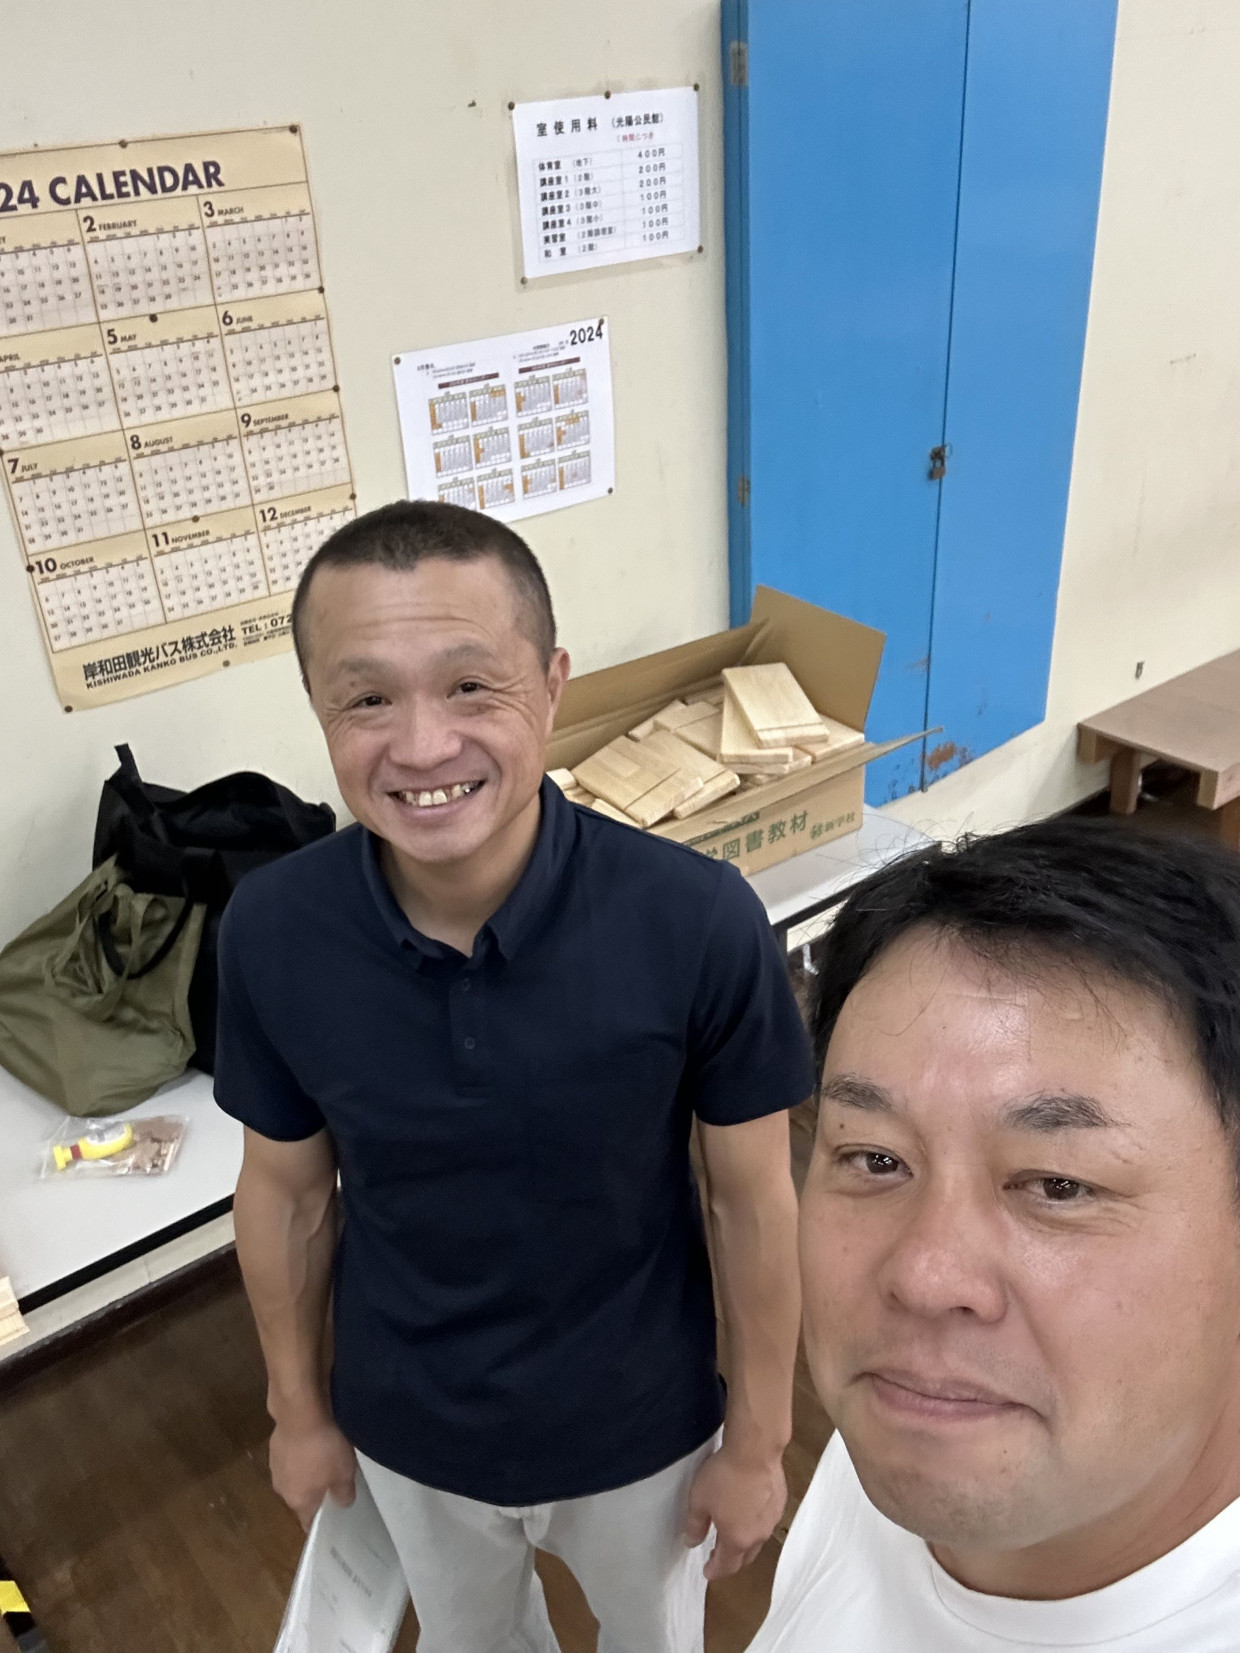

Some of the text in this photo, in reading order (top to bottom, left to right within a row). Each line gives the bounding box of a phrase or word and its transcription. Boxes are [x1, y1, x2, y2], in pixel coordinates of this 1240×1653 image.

[637, 147, 665, 158] 400円
[0, 160, 225, 212] 24 CALENDAR
[639, 176, 666, 188] 200円
[640, 189, 667, 201] 100円
[203, 201, 215, 218] 3
[217, 206, 244, 216] MARCH
[641, 203, 668, 215] 100円
[83, 215, 97, 233] 2
[98, 220, 137, 231] FEBRUARY
[642, 217, 668, 229] 100円
[643, 230, 669, 242] 100円
[222, 310, 233, 326] 6
[236, 315, 253, 324] JUNE
[107, 328, 118, 345] 5
[120, 334, 137, 343] MAY
[570, 325, 603, 346] 2024
[240, 413, 289, 428] 9 SEPTEMBER
[130, 434, 173, 450] 8 AUGUST
[7, 457, 38, 474] 7 JULY
[259, 506, 311, 523] 12 DECEMBER
[151, 529, 210, 548] 11 NOVEMBER
[35, 556, 94, 575] 10 OCTOBER
[82, 624, 237, 682] 岸和田観光バス株式会社
[86, 668, 141, 690] KISHIWADA
[143, 658, 177, 673] KANKO
[179, 652, 198, 663] BUS
